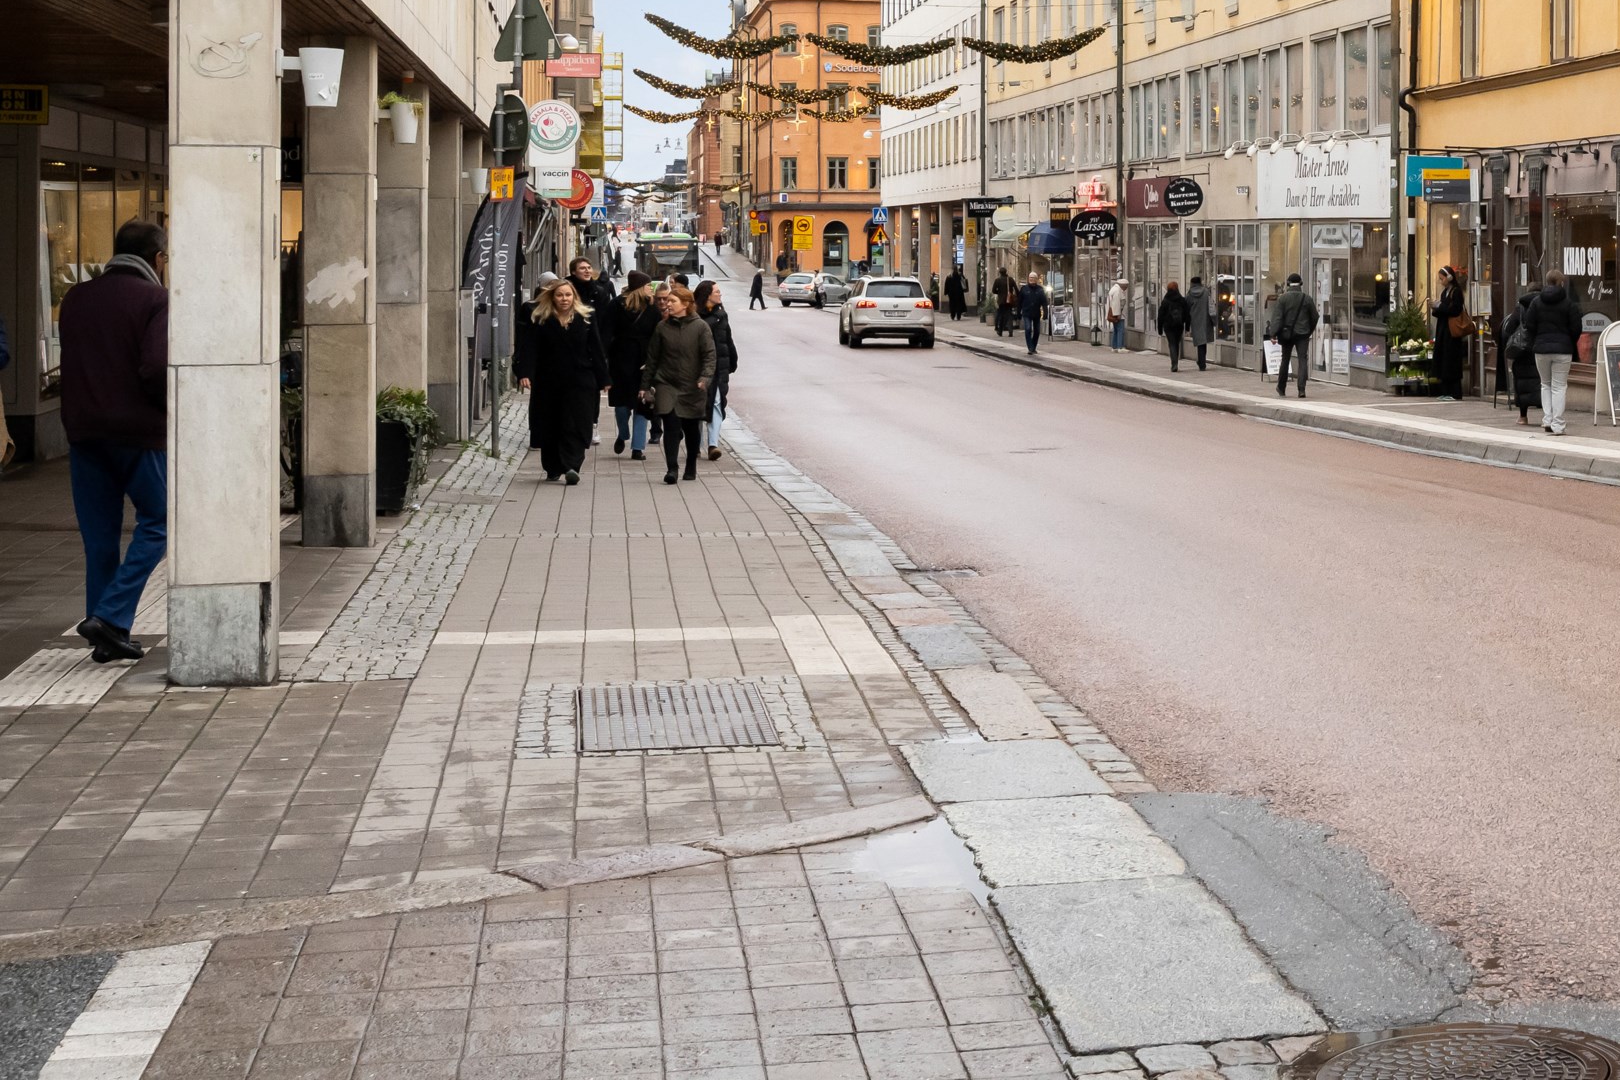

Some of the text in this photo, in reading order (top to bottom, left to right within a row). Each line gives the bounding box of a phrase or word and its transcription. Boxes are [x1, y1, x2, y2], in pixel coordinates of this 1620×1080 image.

[530, 106, 552, 123] MASALA
[560, 108, 573, 124] PIZZA
[1294, 152, 1349, 178] Mäster Arnes
[1168, 191, 1198, 199] Korrens
[1170, 199, 1199, 207] Kuriosa
[1285, 187, 1300, 208] Dam
[1309, 186, 1326, 207] Herr
[1327, 184, 1361, 207] skrädderi
[1051, 212, 1070, 220] KAFFE
[1075, 220, 1115, 231] Larsson
[1563, 246, 1602, 276] KHAO SOI
[1587, 280, 1596, 299] by
